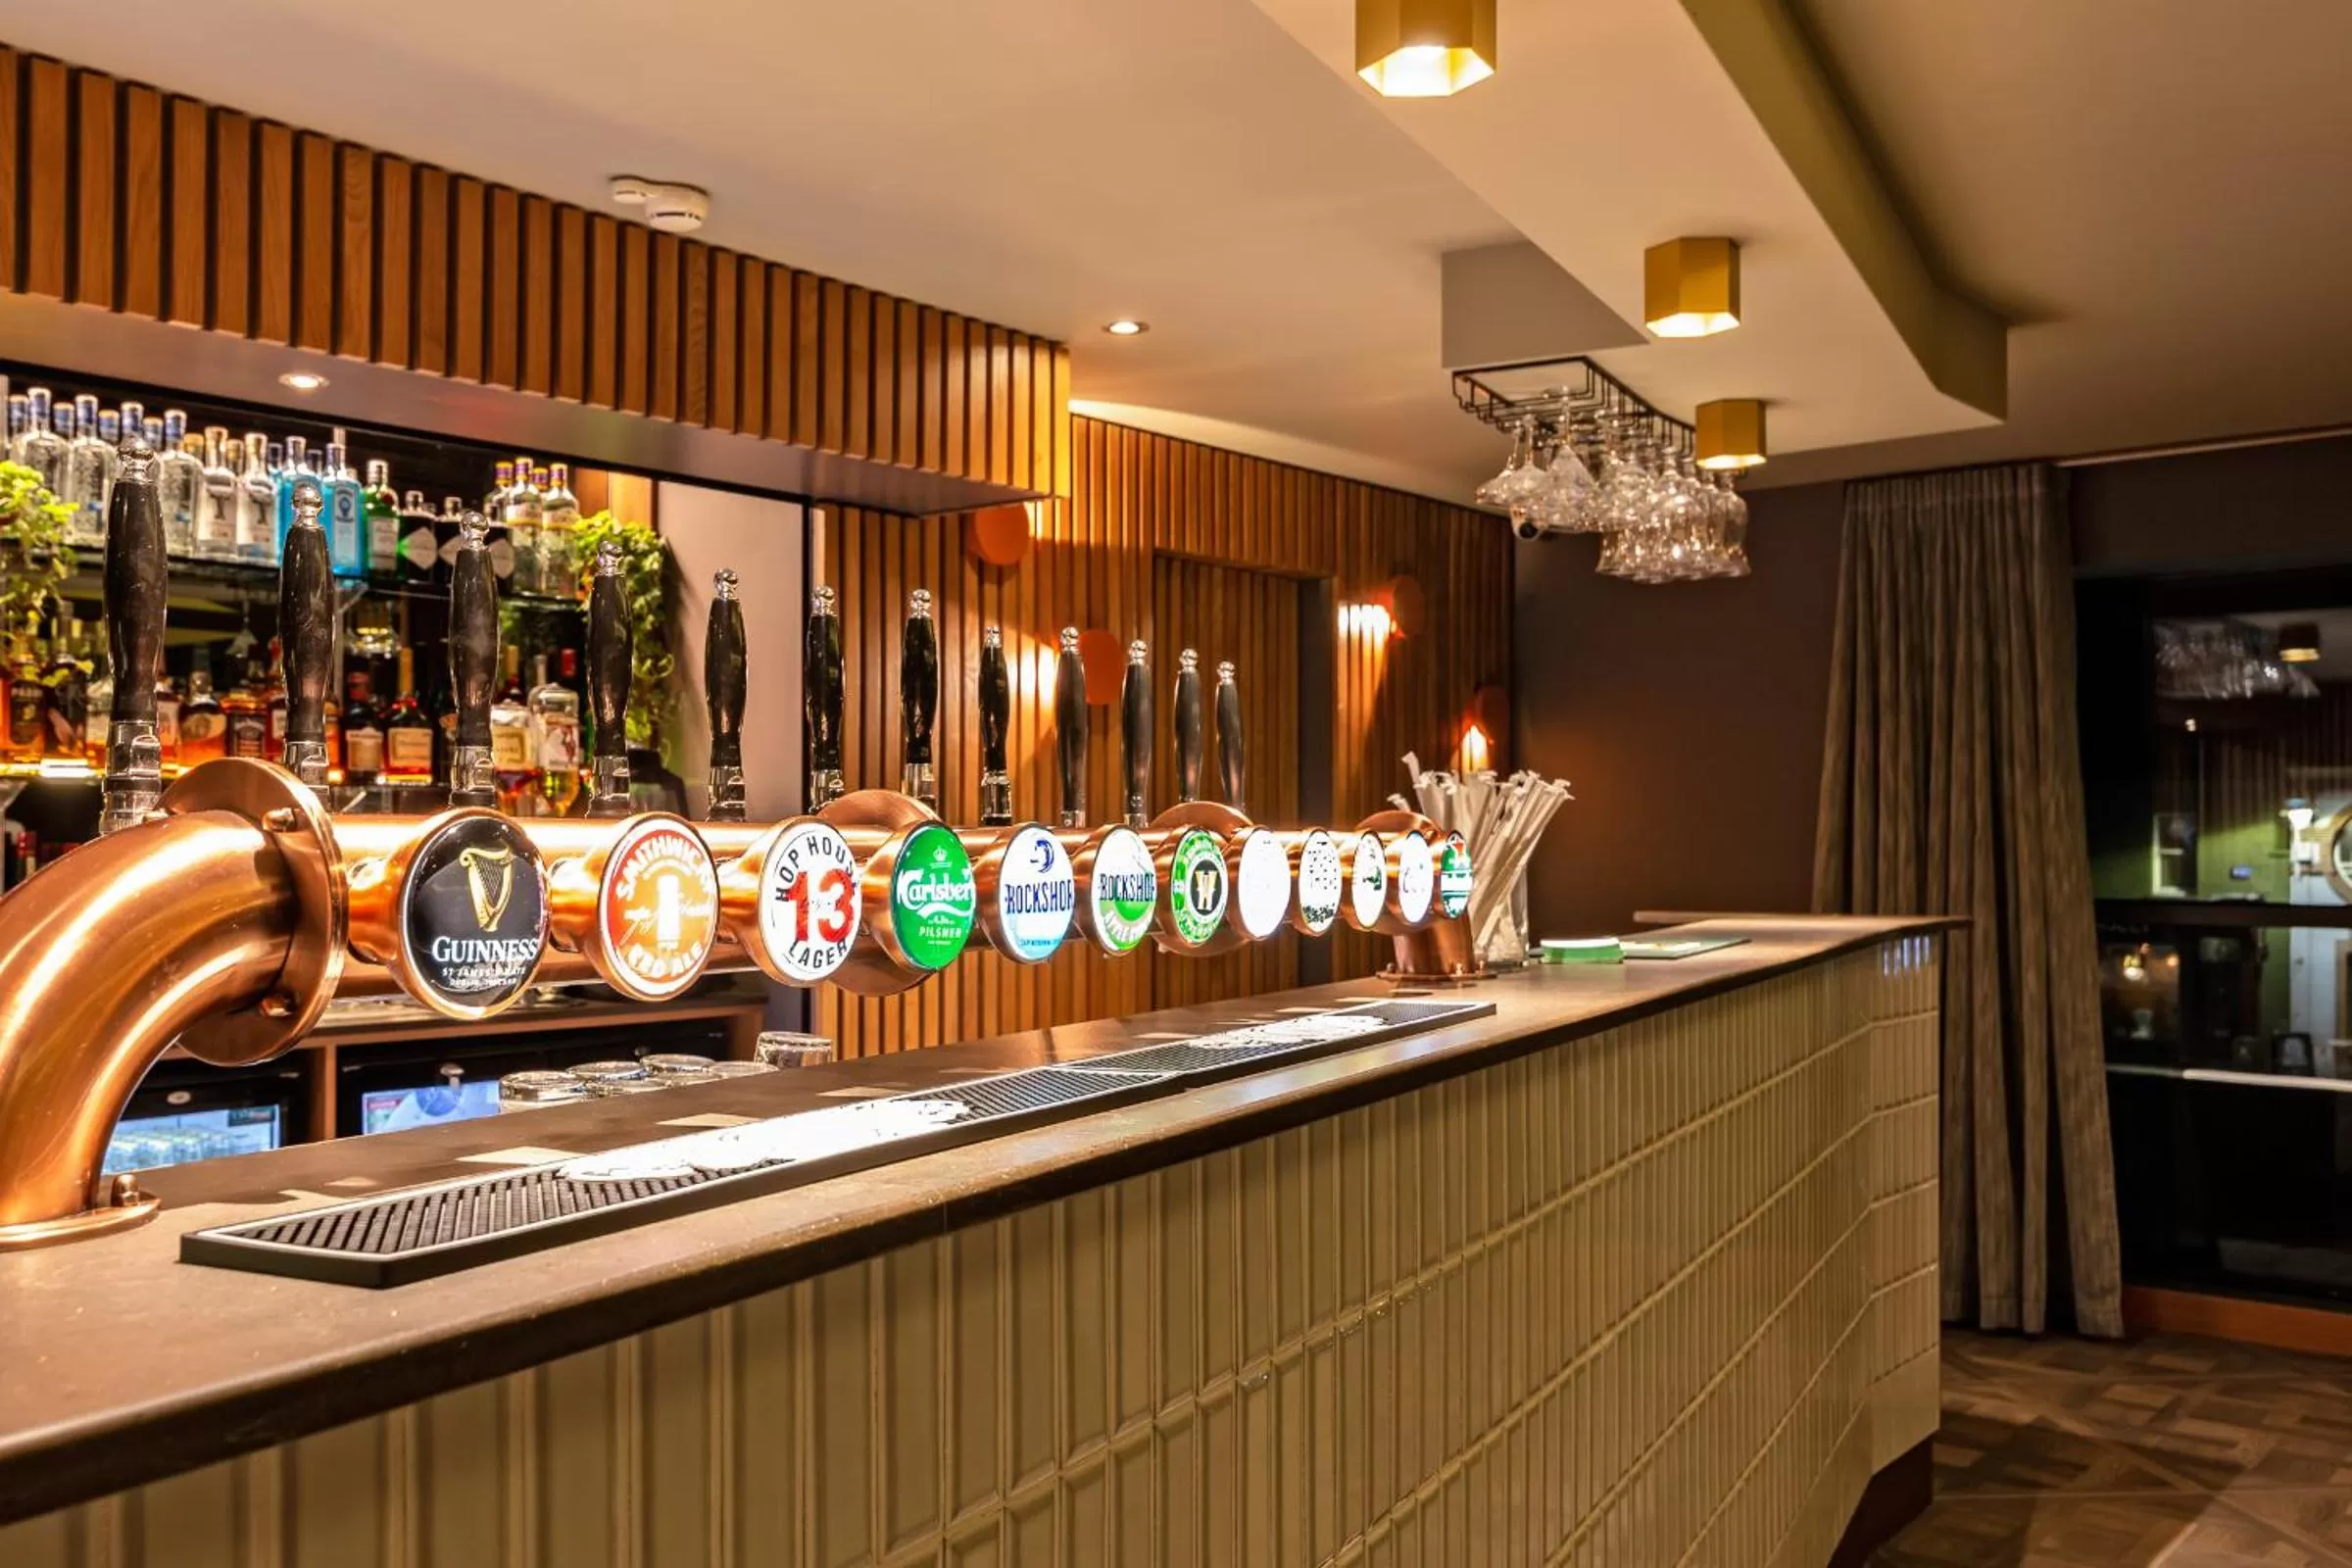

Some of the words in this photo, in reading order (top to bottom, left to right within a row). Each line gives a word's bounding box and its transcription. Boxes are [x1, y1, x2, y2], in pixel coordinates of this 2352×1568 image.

[775, 849, 799, 903] HOP
[788, 868, 855, 944] 13
[918, 926, 961, 938] PILSNER
[431, 935, 539, 962] GUINNESS
[789, 937, 847, 968] LAGER
